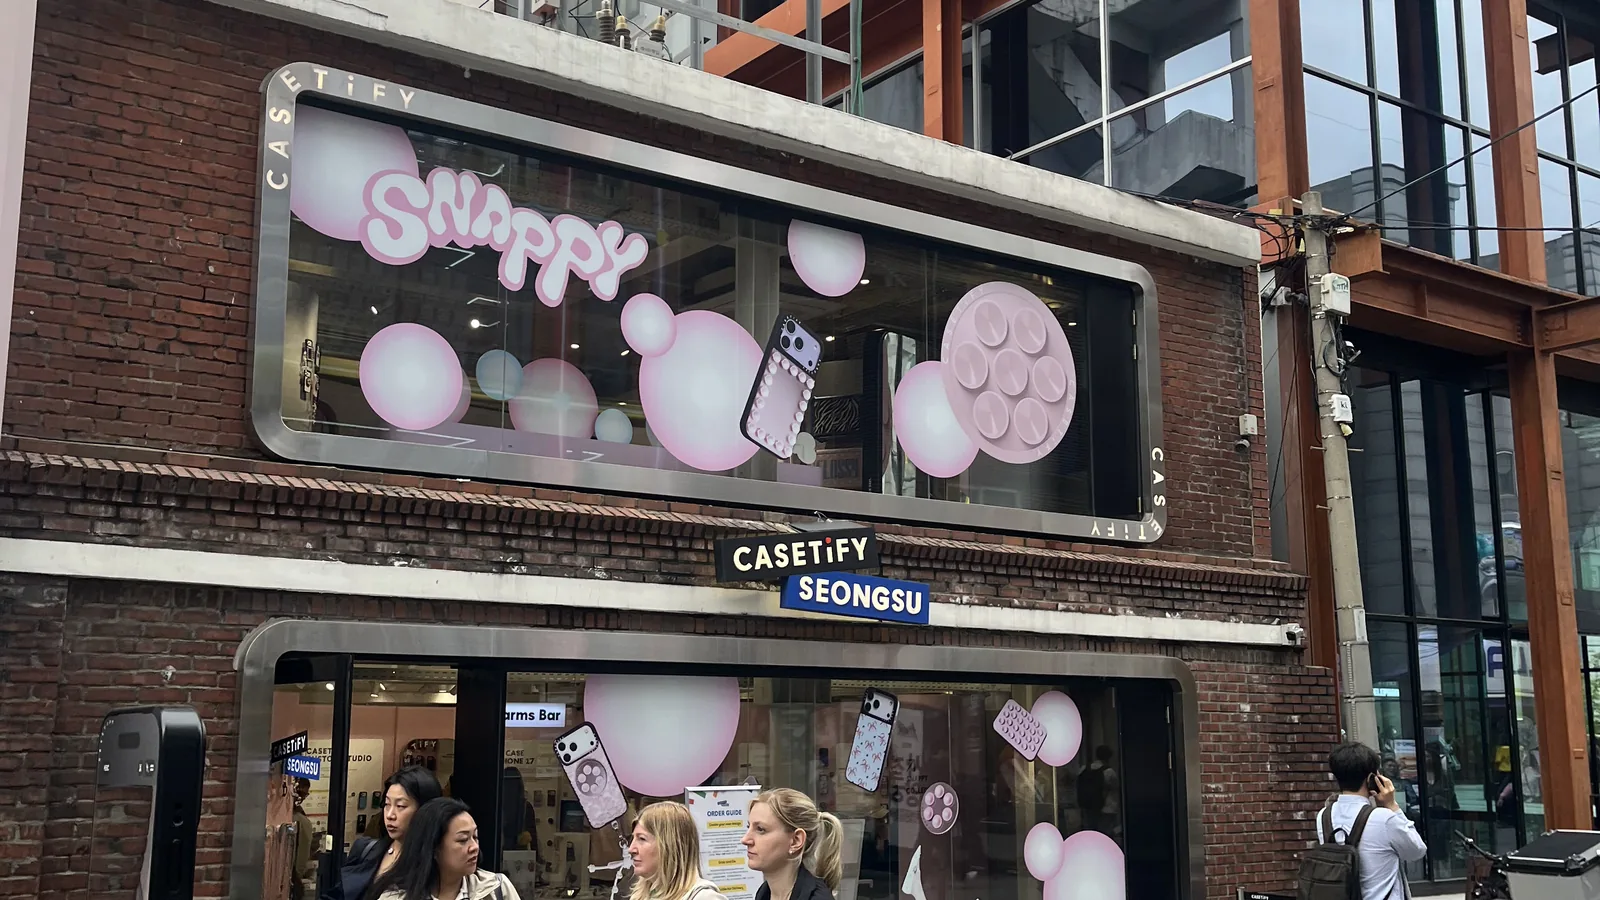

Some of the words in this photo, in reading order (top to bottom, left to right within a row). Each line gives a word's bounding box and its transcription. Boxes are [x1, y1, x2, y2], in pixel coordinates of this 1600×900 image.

[361, 168, 647, 305] SNAPPY
[733, 537, 867, 572] CASETiFY
[799, 576, 922, 615] SEONGSU
[505, 711, 535, 721] arms
[539, 709, 561, 720] Bar
[306, 747, 333, 755] CASET
[287, 758, 319, 776] SEONGSU
